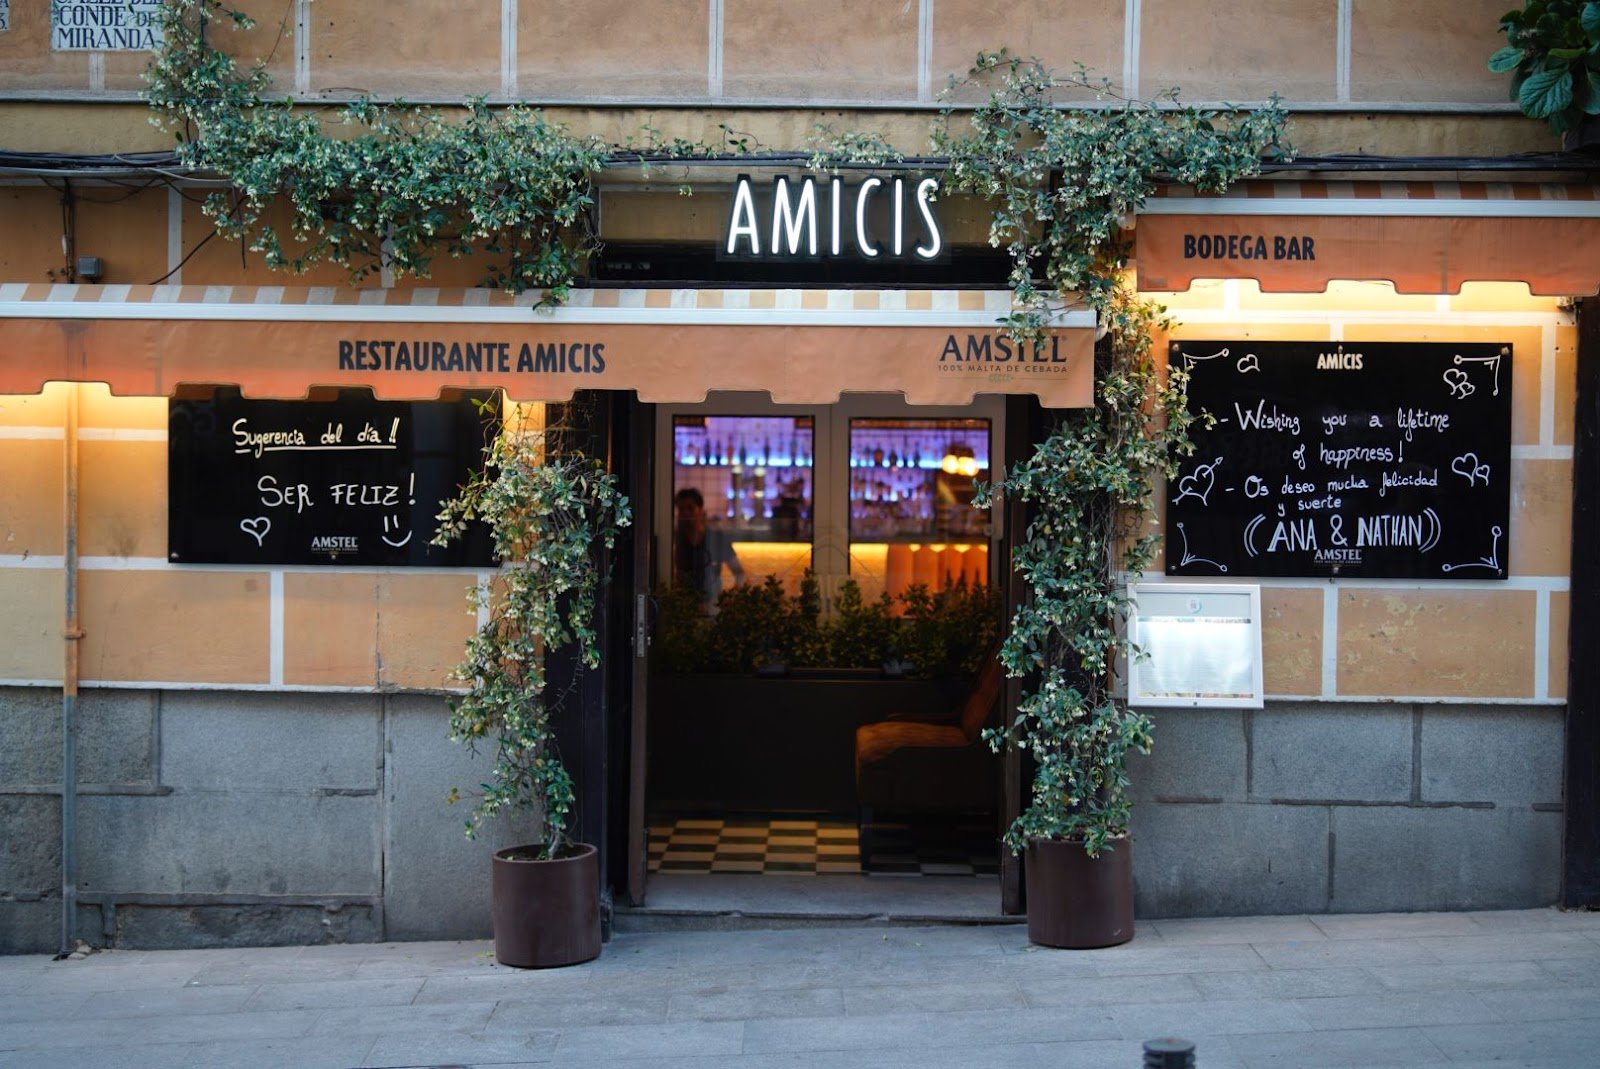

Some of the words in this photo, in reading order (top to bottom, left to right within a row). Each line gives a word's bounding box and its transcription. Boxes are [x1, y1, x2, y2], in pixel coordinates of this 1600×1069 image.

[59, 5, 126, 27] CONDE
[57, 28, 155, 48] MIRANDA
[726, 177, 942, 258] AMICIS
[1184, 235, 1268, 260] BODEGA
[1274, 236, 1315, 261] BAR
[338, 340, 511, 372] RESTAURANTE
[516, 343, 605, 373] AMICIS
[968, 365, 1001, 373] MALTA
[1006, 365, 1020, 373] DE
[1024, 365, 1068, 374] CEBADA
[1316, 353, 1364, 371] AMICIS
[1234, 399, 1301, 435] Wishing
[1321, 414, 1348, 435] you
[1368, 415, 1383, 428] a
[1397, 407, 1450, 442] lifetime
[232, 417, 306, 459] Sugerencia
[320, 422, 343, 443] del
[1292, 443, 1306, 470] of
[1244, 475, 1269, 498] Os
[1281, 474, 1316, 494] deseo
[1327, 474, 1369, 492] mucha
[1379, 468, 1438, 497] felicidad
[1277, 503, 1286, 517] y
[1298, 494, 1342, 510] suerte
[311, 536, 359, 548] AMSTEL
[1330, 514, 1348, 547] &
[1314, 549, 1362, 560] AMSTEL
